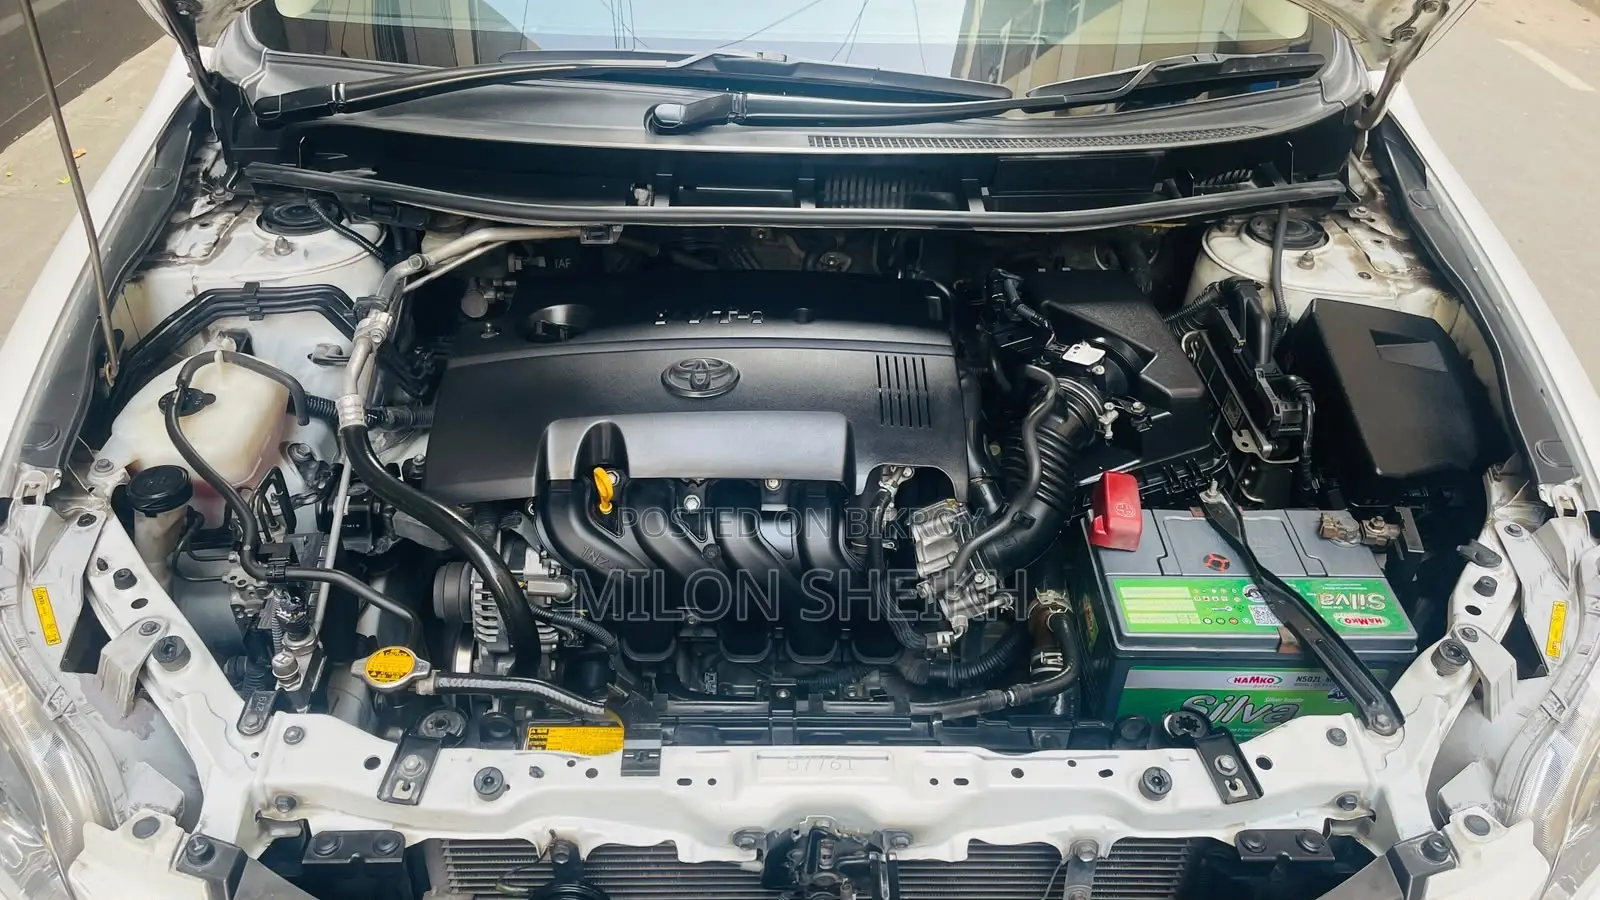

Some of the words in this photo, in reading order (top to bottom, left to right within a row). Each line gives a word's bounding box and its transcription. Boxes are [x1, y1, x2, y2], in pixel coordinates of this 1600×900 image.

[1319, 592, 1386, 610] Silva
[1233, 676, 1275, 684] HAMKO
[1181, 694, 1300, 724] Silva
